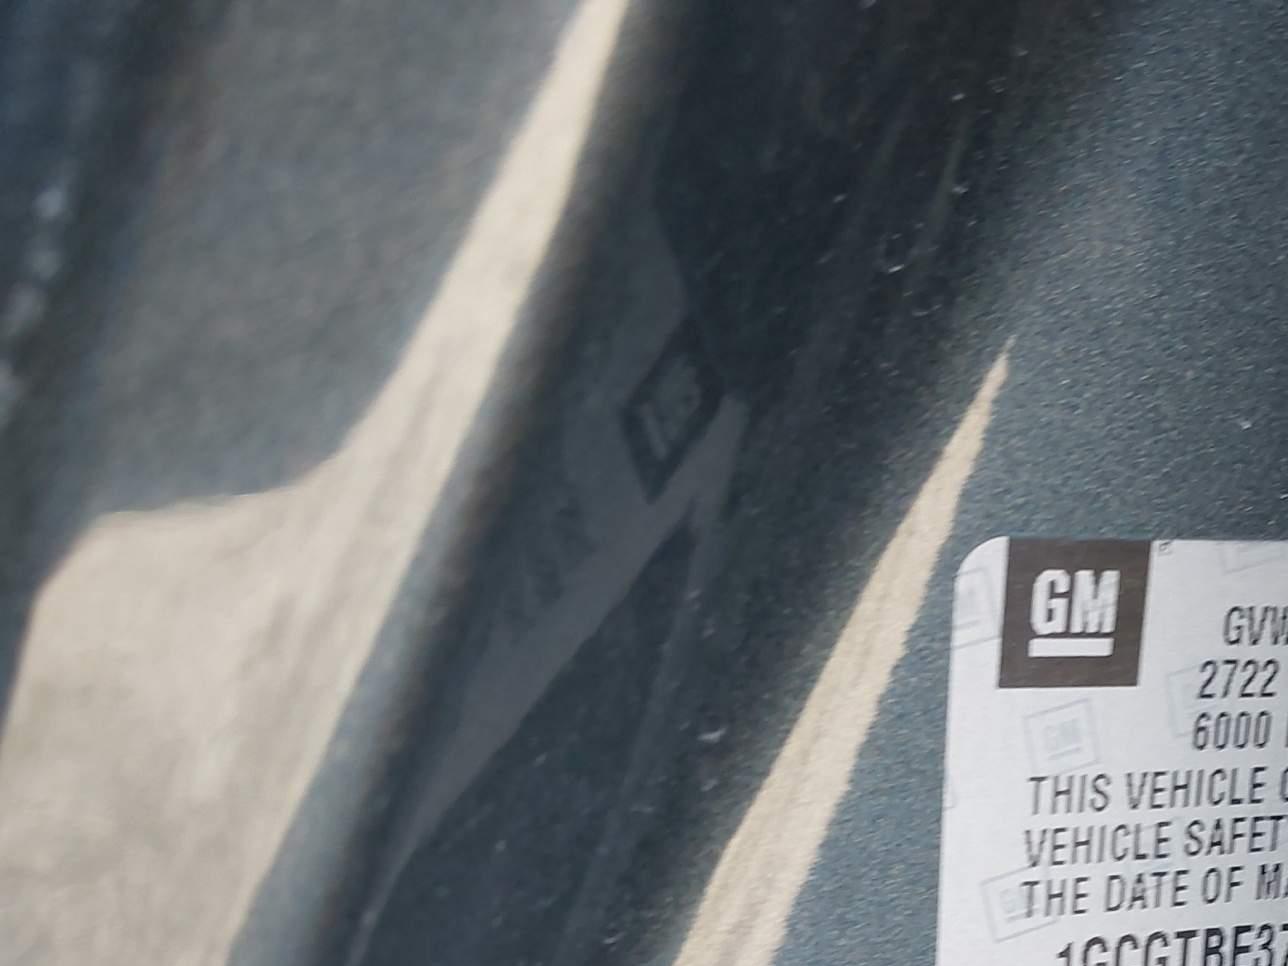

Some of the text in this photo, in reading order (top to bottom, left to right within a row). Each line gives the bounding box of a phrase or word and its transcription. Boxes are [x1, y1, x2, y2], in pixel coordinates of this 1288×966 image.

[1032, 569, 1120, 634] GM
[1199, 660, 1276, 699] 2722
[1193, 711, 1272, 750] 6000
[1029, 776, 1109, 815] THIS
[1126, 768, 1266, 811] VEHICLE
[1024, 821, 1171, 868] VEHICLE
[1021, 877, 1089, 918] THE
[1104, 873, 1188, 913] DATE
[1201, 867, 1244, 905] OF
